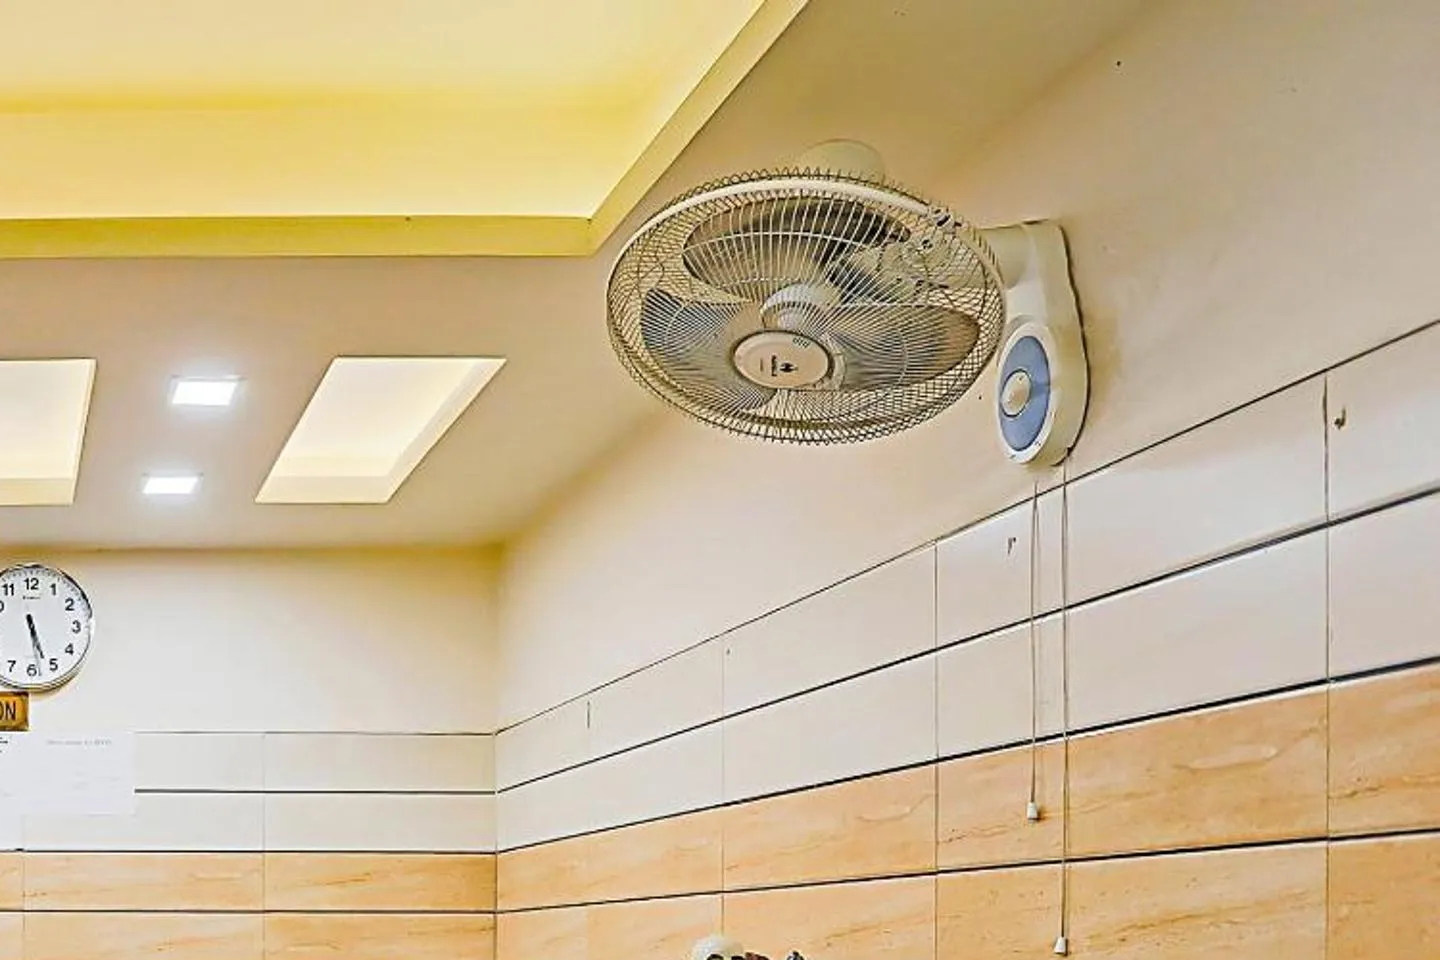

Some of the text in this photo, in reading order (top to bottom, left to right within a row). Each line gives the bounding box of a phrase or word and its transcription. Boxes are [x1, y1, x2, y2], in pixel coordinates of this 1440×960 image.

[2, 583, 15, 596] 11
[24, 577, 39, 590] 12
[50, 583, 57, 595] 1
[65, 598, 75, 611] 2
[71, 620, 81, 634] 3
[64, 643, 74, 655] 4
[7, 660, 17, 672] 7
[26, 664, 37, 677] 6
[49, 658, 58, 671] 5
